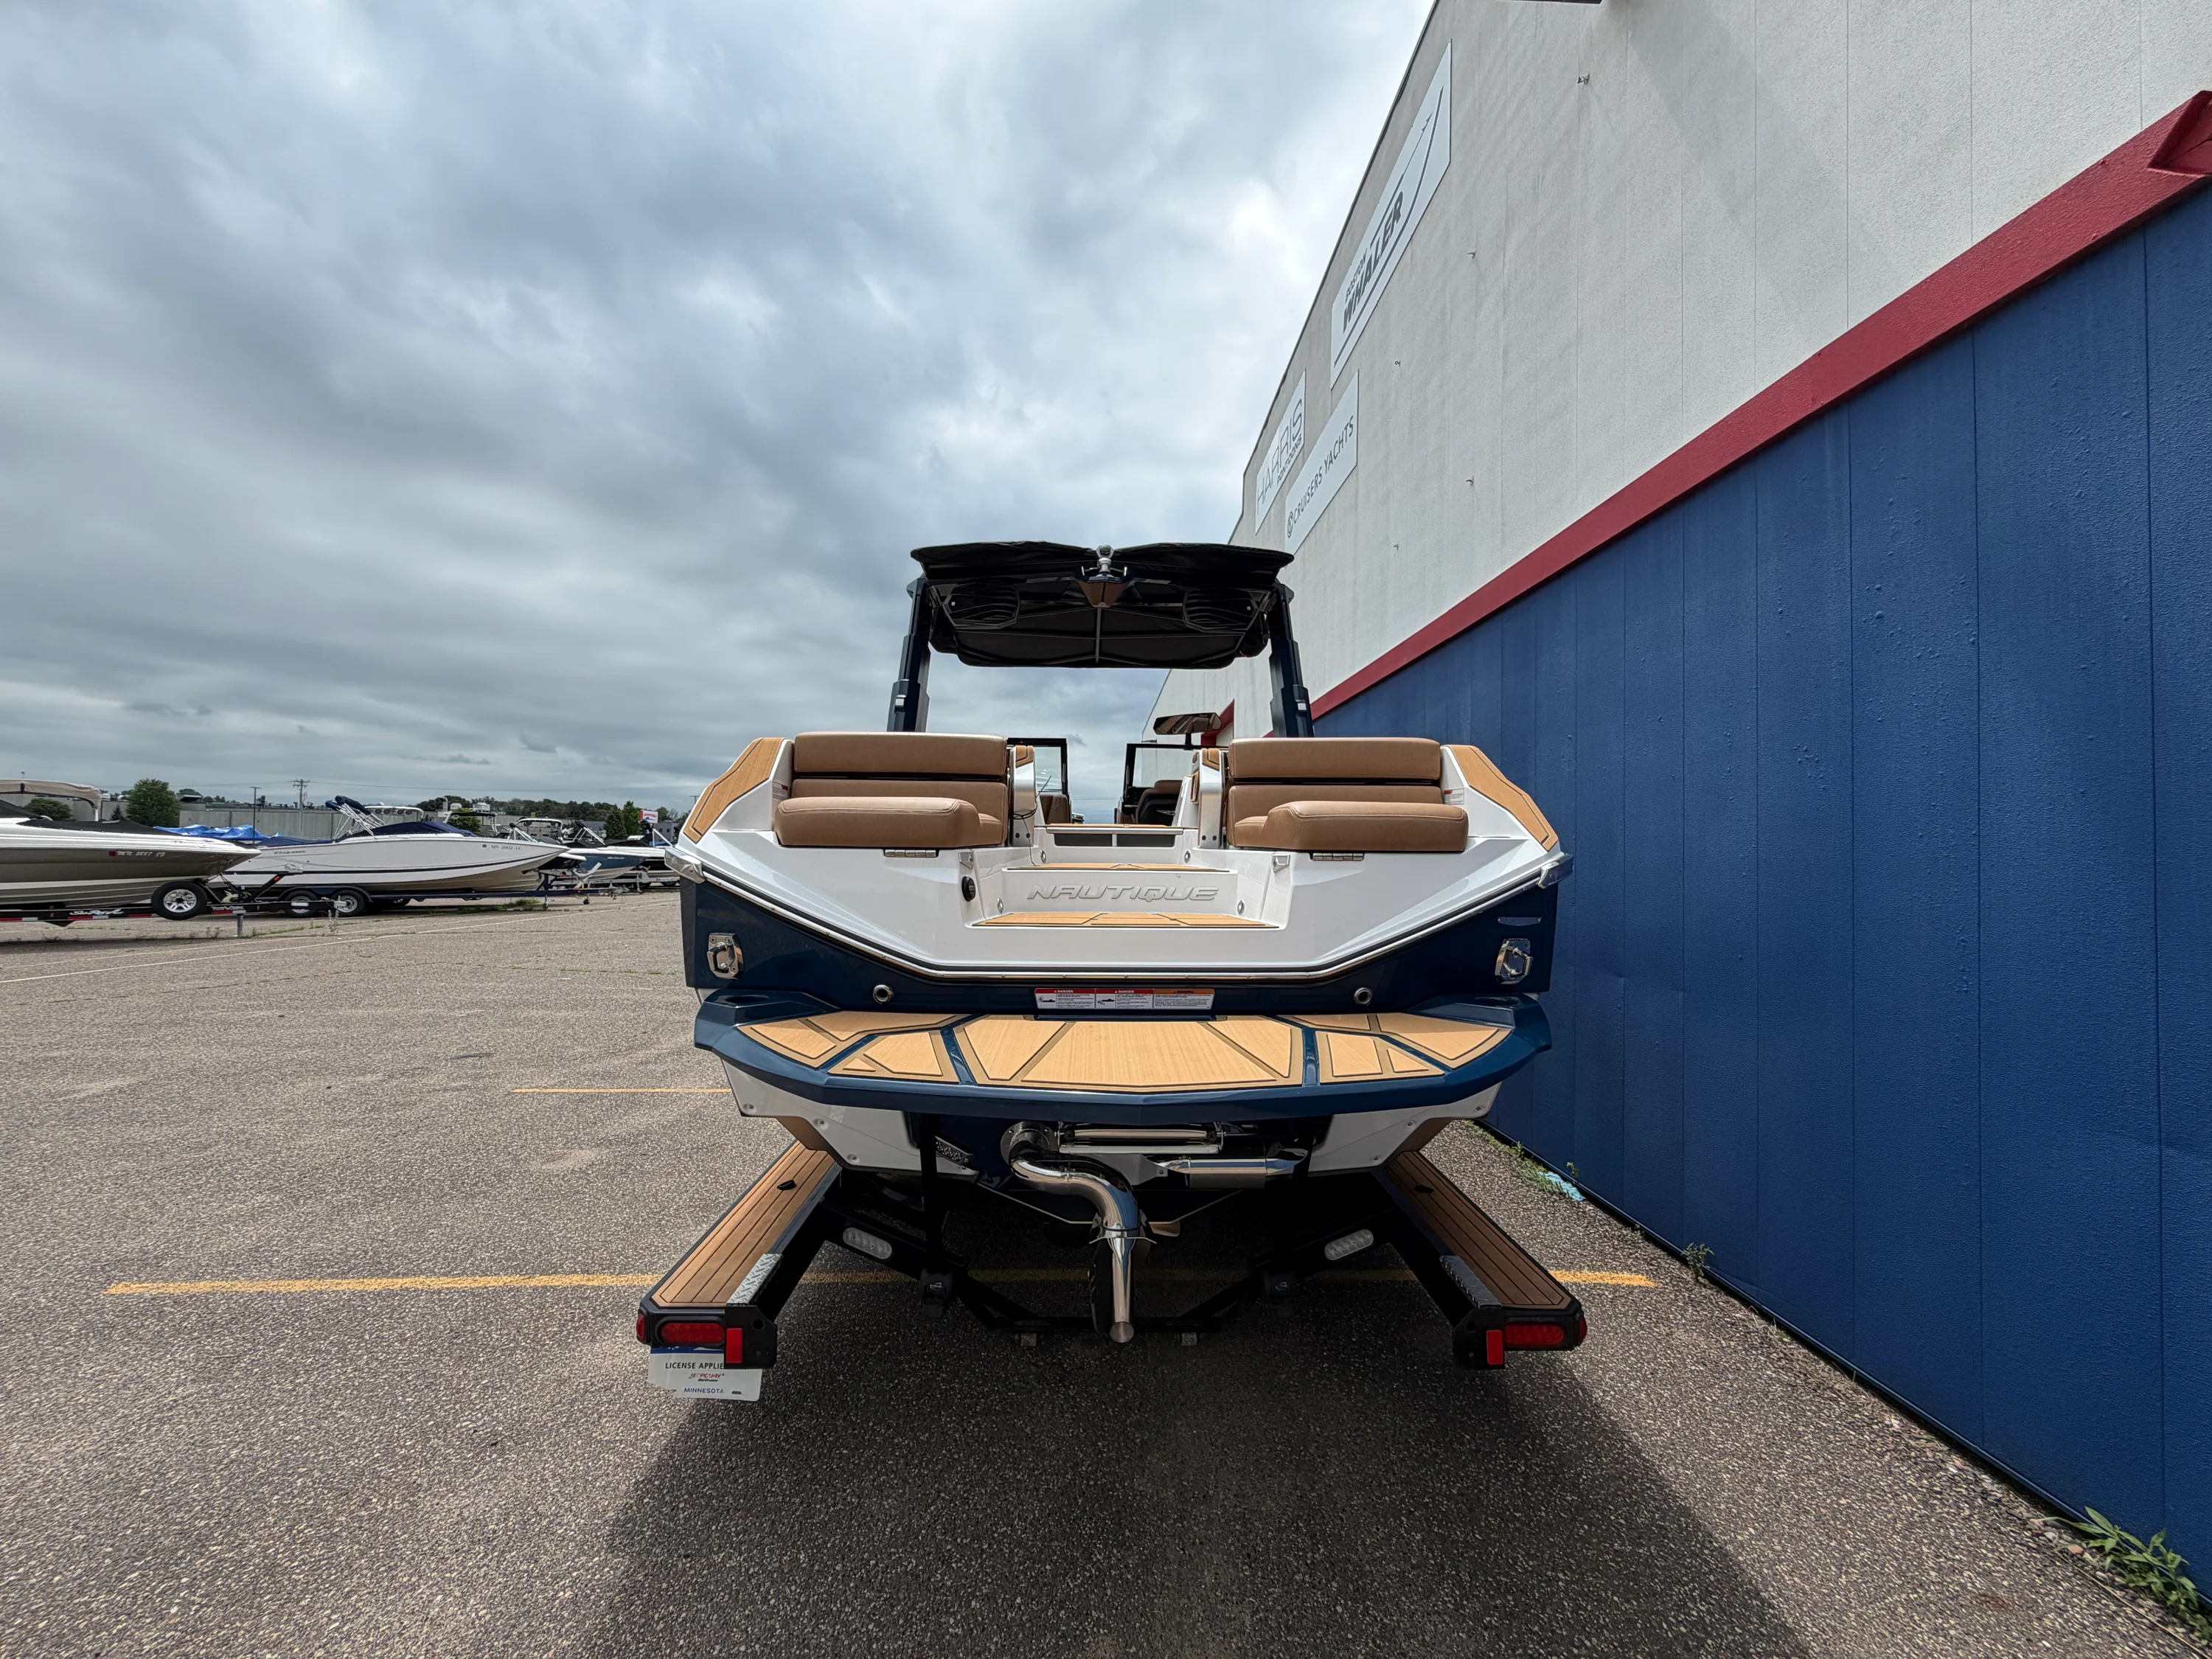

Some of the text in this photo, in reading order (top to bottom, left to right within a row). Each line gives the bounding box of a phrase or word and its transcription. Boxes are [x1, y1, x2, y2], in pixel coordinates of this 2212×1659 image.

[1343, 191, 1404, 334] WHALER
[1345, 248, 1368, 304] BOSTON
[1256, 398, 1303, 515] HARRIS
[1276, 434, 1303, 486] PONTOONS
[1293, 414, 1354, 524] CRUISERS YACHTS
[1026, 885, 1220, 902] NAUTIQUE
[698, 1362, 724, 1370] APPLIE
